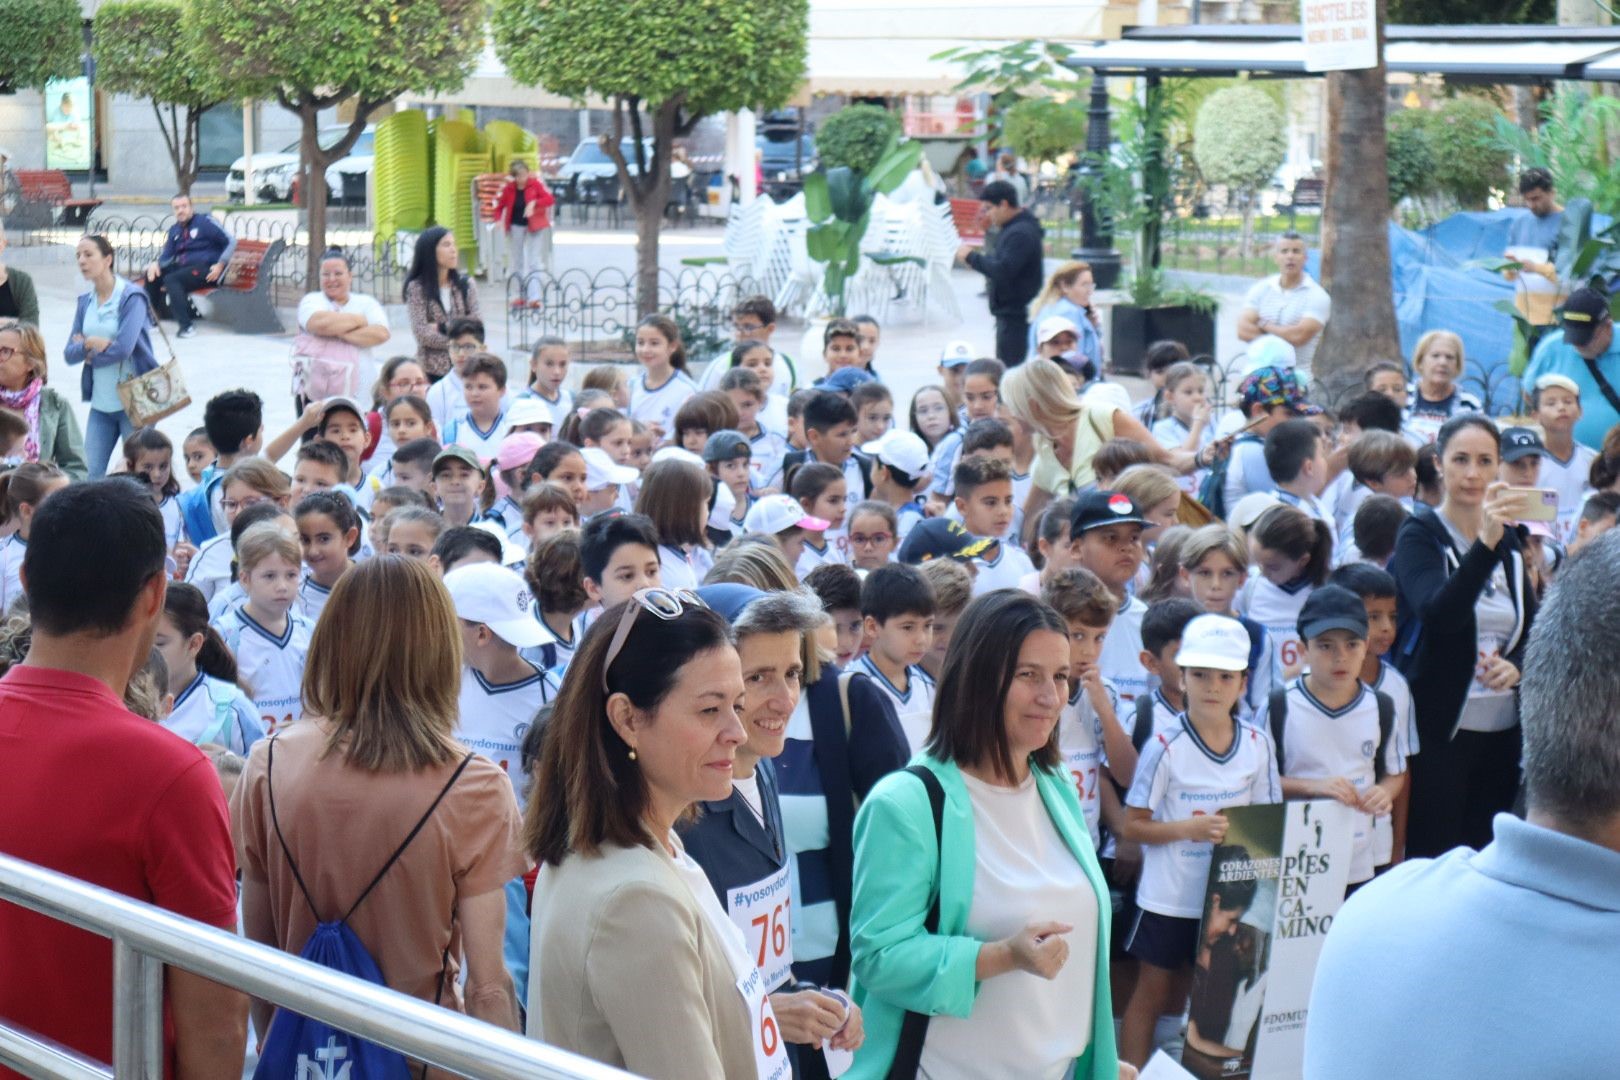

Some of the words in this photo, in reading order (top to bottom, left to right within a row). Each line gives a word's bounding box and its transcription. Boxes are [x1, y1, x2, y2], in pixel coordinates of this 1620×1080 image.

[1218, 868, 1280, 882] ARDIENTES
[1220, 858, 1280, 873] CORAZONES
[1282, 876, 1311, 898] EN
[1279, 898, 1313, 919] CA-
[1277, 915, 1335, 940] MINO
